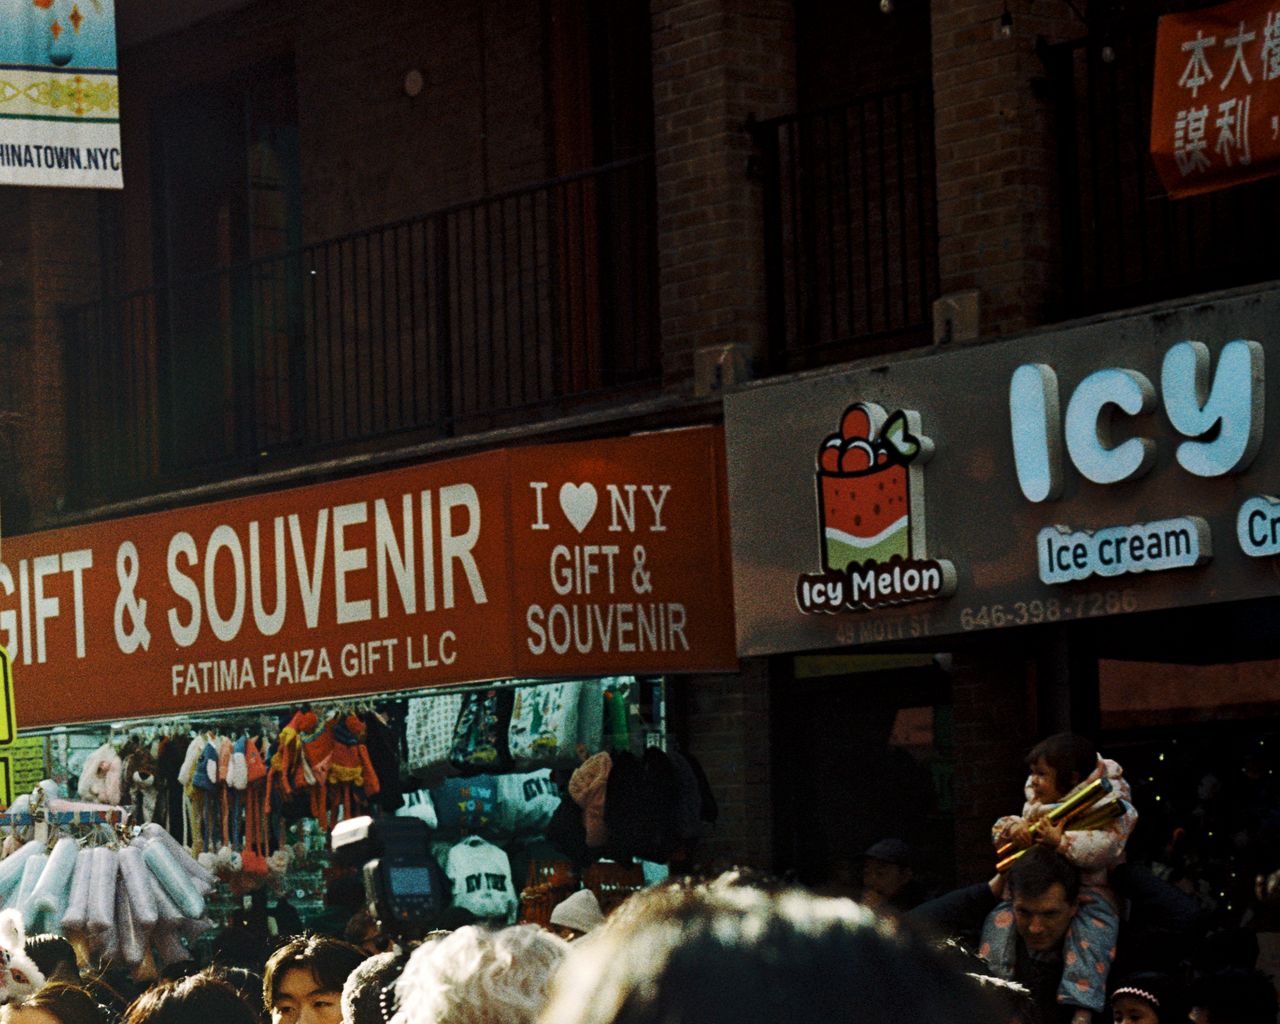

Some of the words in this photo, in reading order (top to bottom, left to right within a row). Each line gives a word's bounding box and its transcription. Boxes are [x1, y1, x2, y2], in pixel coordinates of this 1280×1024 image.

[1009, 340, 1260, 502] Icy
[529, 482, 550, 530] I
[606, 484, 671, 532] NY
[114, 540, 151, 654] &
[167, 483, 488, 647] SOUVENIR
[550, 544, 619, 595] GIFT
[631, 544, 653, 594] &
[1047, 537, 1088, 573] Ice
[1099, 528, 1191, 566] cream
[803, 581, 842, 607] Icy
[852, 566, 940, 601] Melon
[526, 603, 690, 655] SOUVENIR
[171, 656, 256, 696] FATIMA
[263, 647, 333, 687] FAIZA
[340, 638, 398, 677] GIFT
[406, 630, 457, 669] LLC
